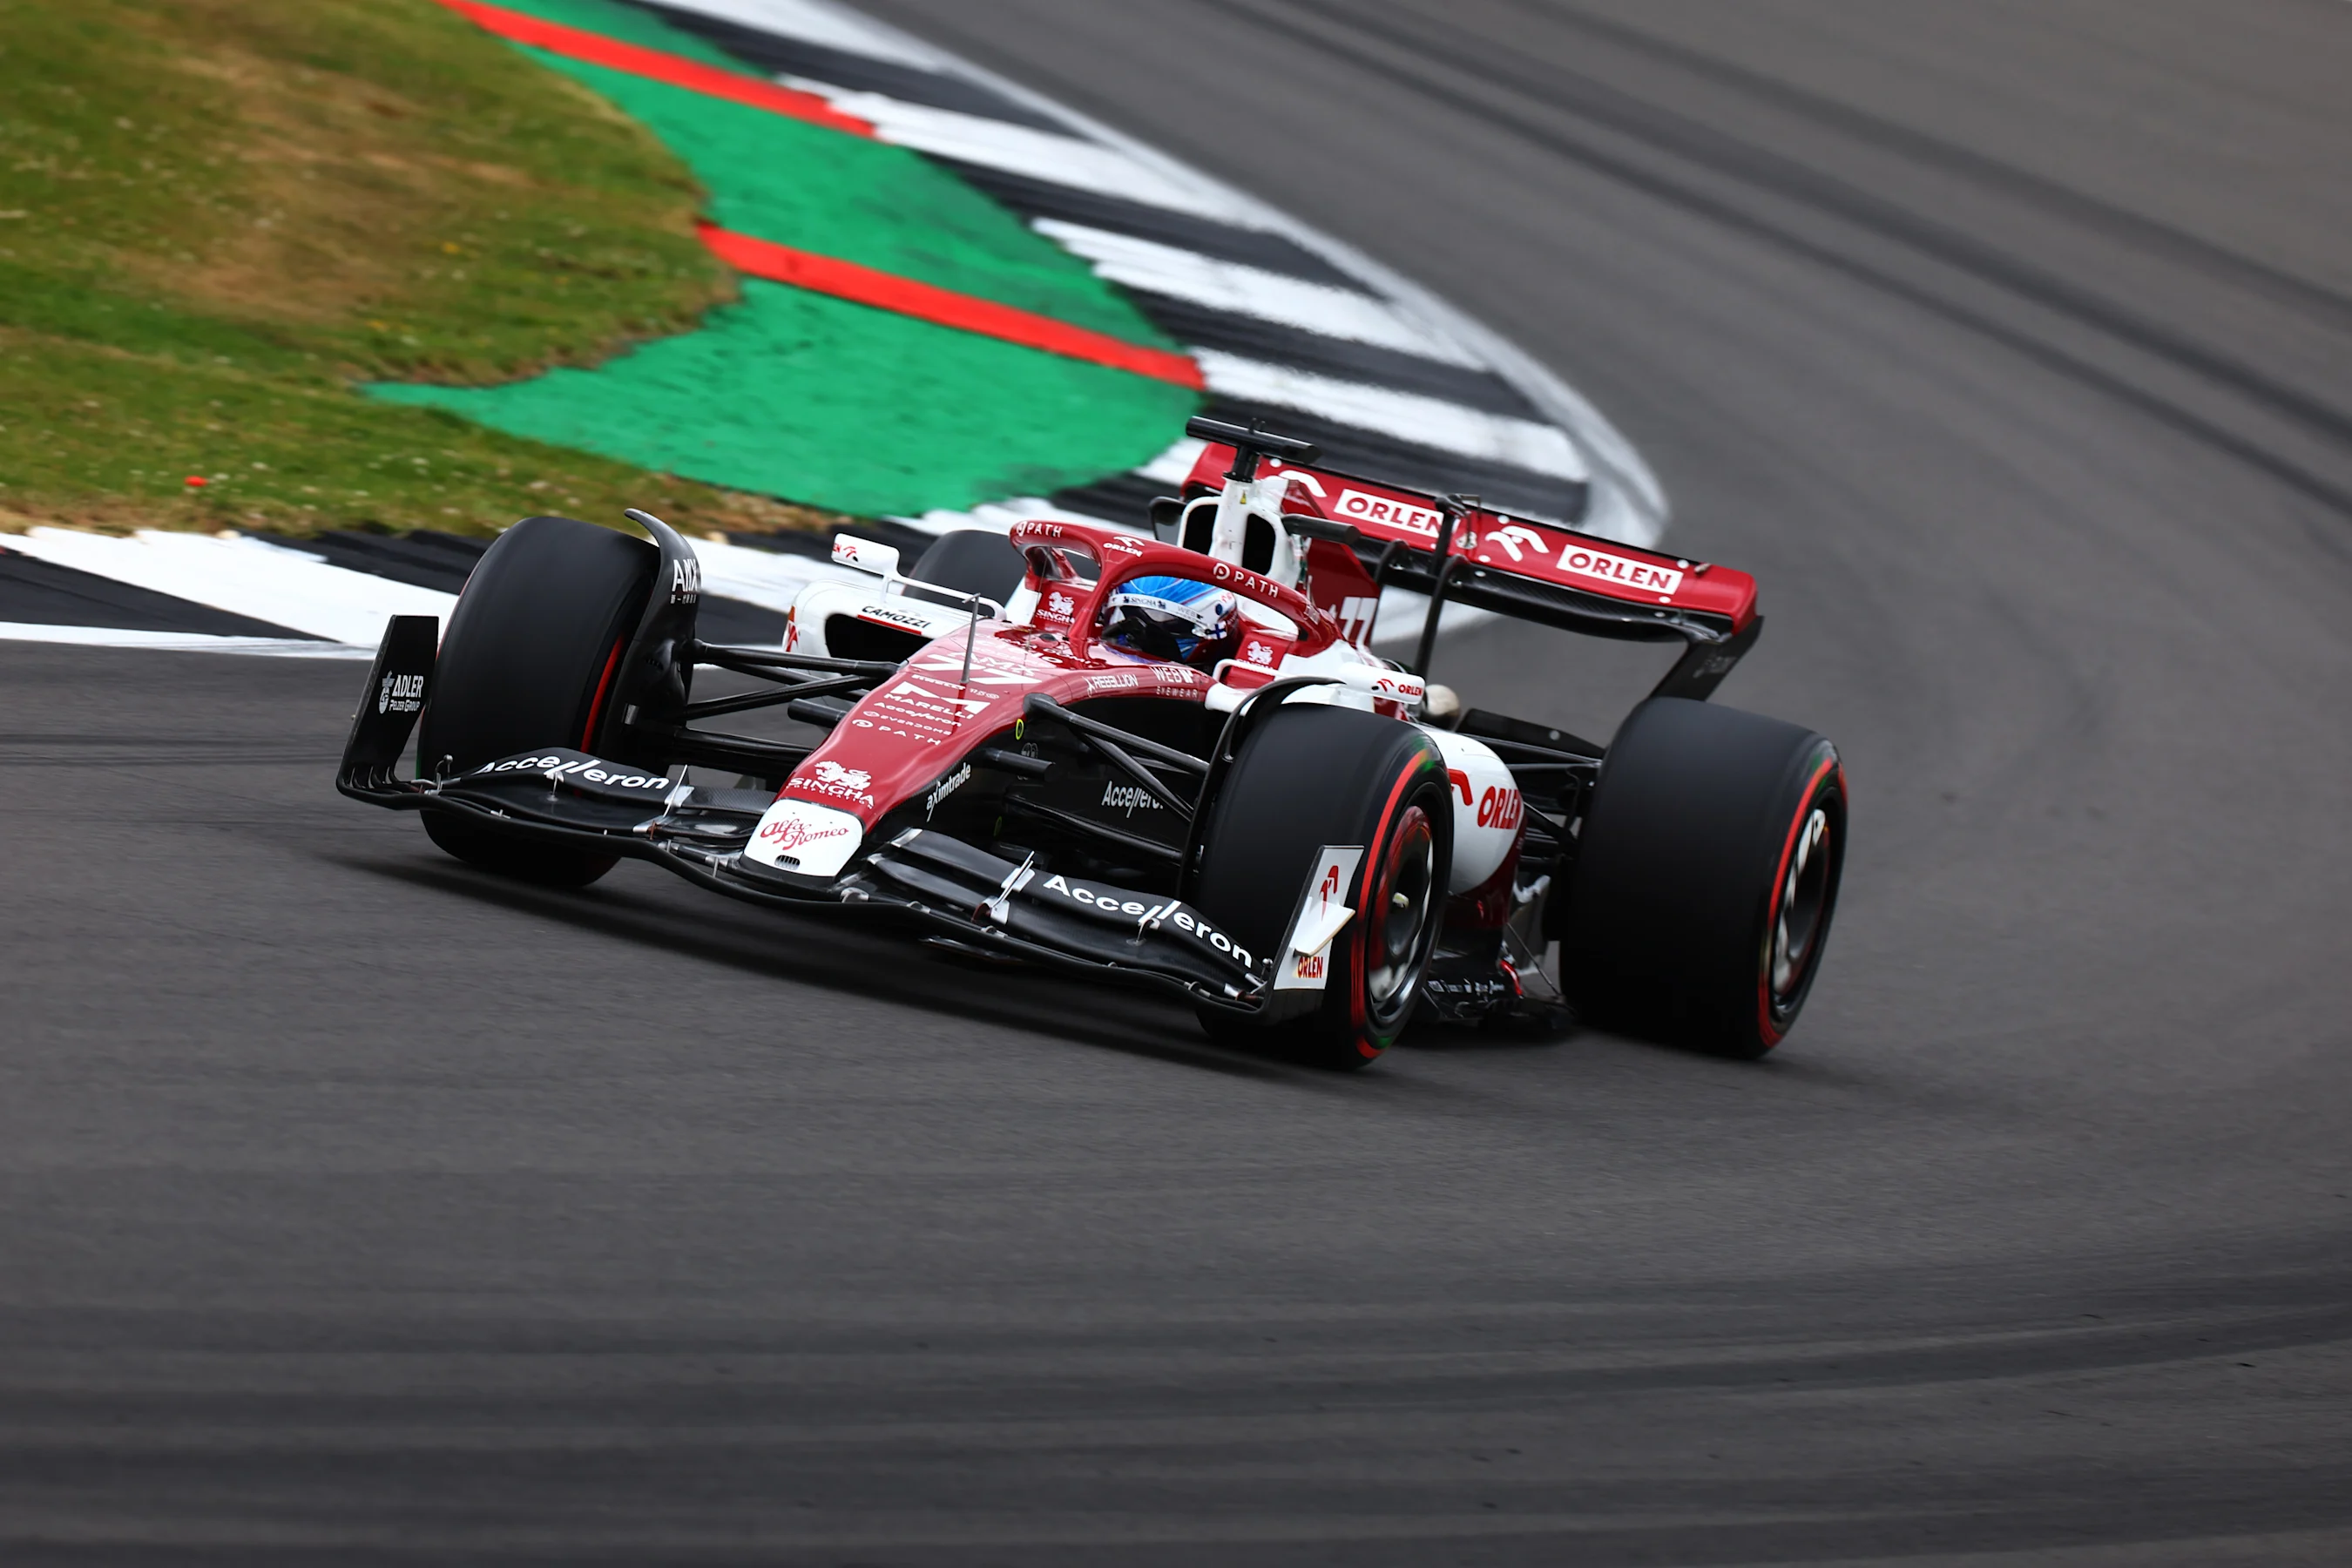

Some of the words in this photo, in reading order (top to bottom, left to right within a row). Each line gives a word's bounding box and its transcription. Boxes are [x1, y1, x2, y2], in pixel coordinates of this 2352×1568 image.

[1026, 523, 1063, 538] PATH
[1103, 542, 1143, 558] ORLEN
[1569, 551, 1673, 590] ORLEN
[1233, 571, 1279, 599] PATH
[861, 605, 932, 629] CAMOZZI
[910, 653, 1044, 686] 77
[1091, 674, 1139, 688] REBELLION
[392, 674, 424, 698] ADLER
[1156, 686, 1198, 699] EYEWEAR
[1398, 683, 1424, 697] ORLEN
[874, 701, 962, 727] Accelleron
[883, 693, 975, 720] MARELLI
[878, 725, 942, 746] PATH
[470, 754, 670, 789] Accelleron
[788, 776, 875, 807] SINGHA
[760, 818, 812, 845] Alfa
[781, 828, 850, 851] Romeo
[1043, 874, 1253, 969] Accelleron
[1297, 956, 1323, 979] ORLEN
